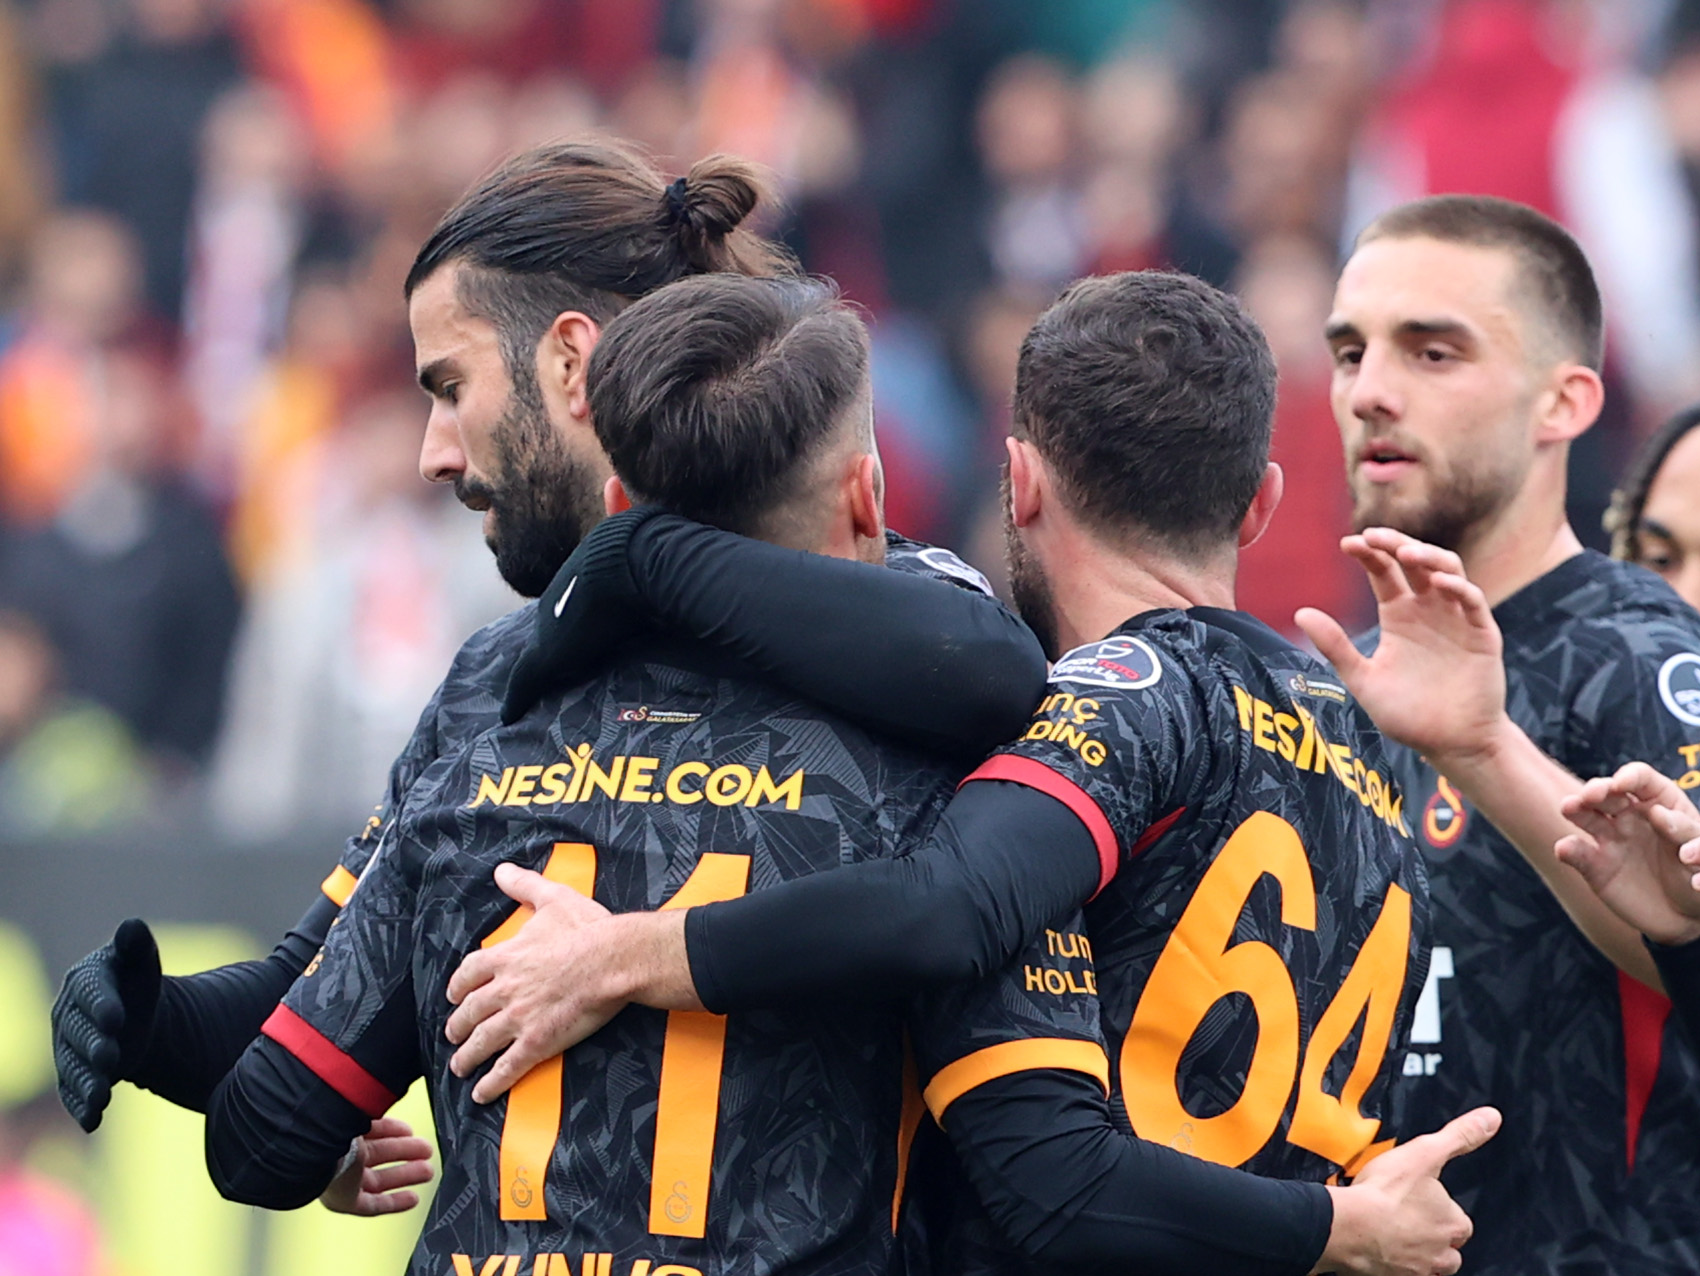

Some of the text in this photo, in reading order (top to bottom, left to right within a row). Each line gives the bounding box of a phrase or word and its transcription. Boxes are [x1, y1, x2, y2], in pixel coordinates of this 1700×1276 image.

[481, 842, 751, 1239] 11
[1119, 810, 1413, 1179] 64
[1402, 1052, 1443, 1077] ar
